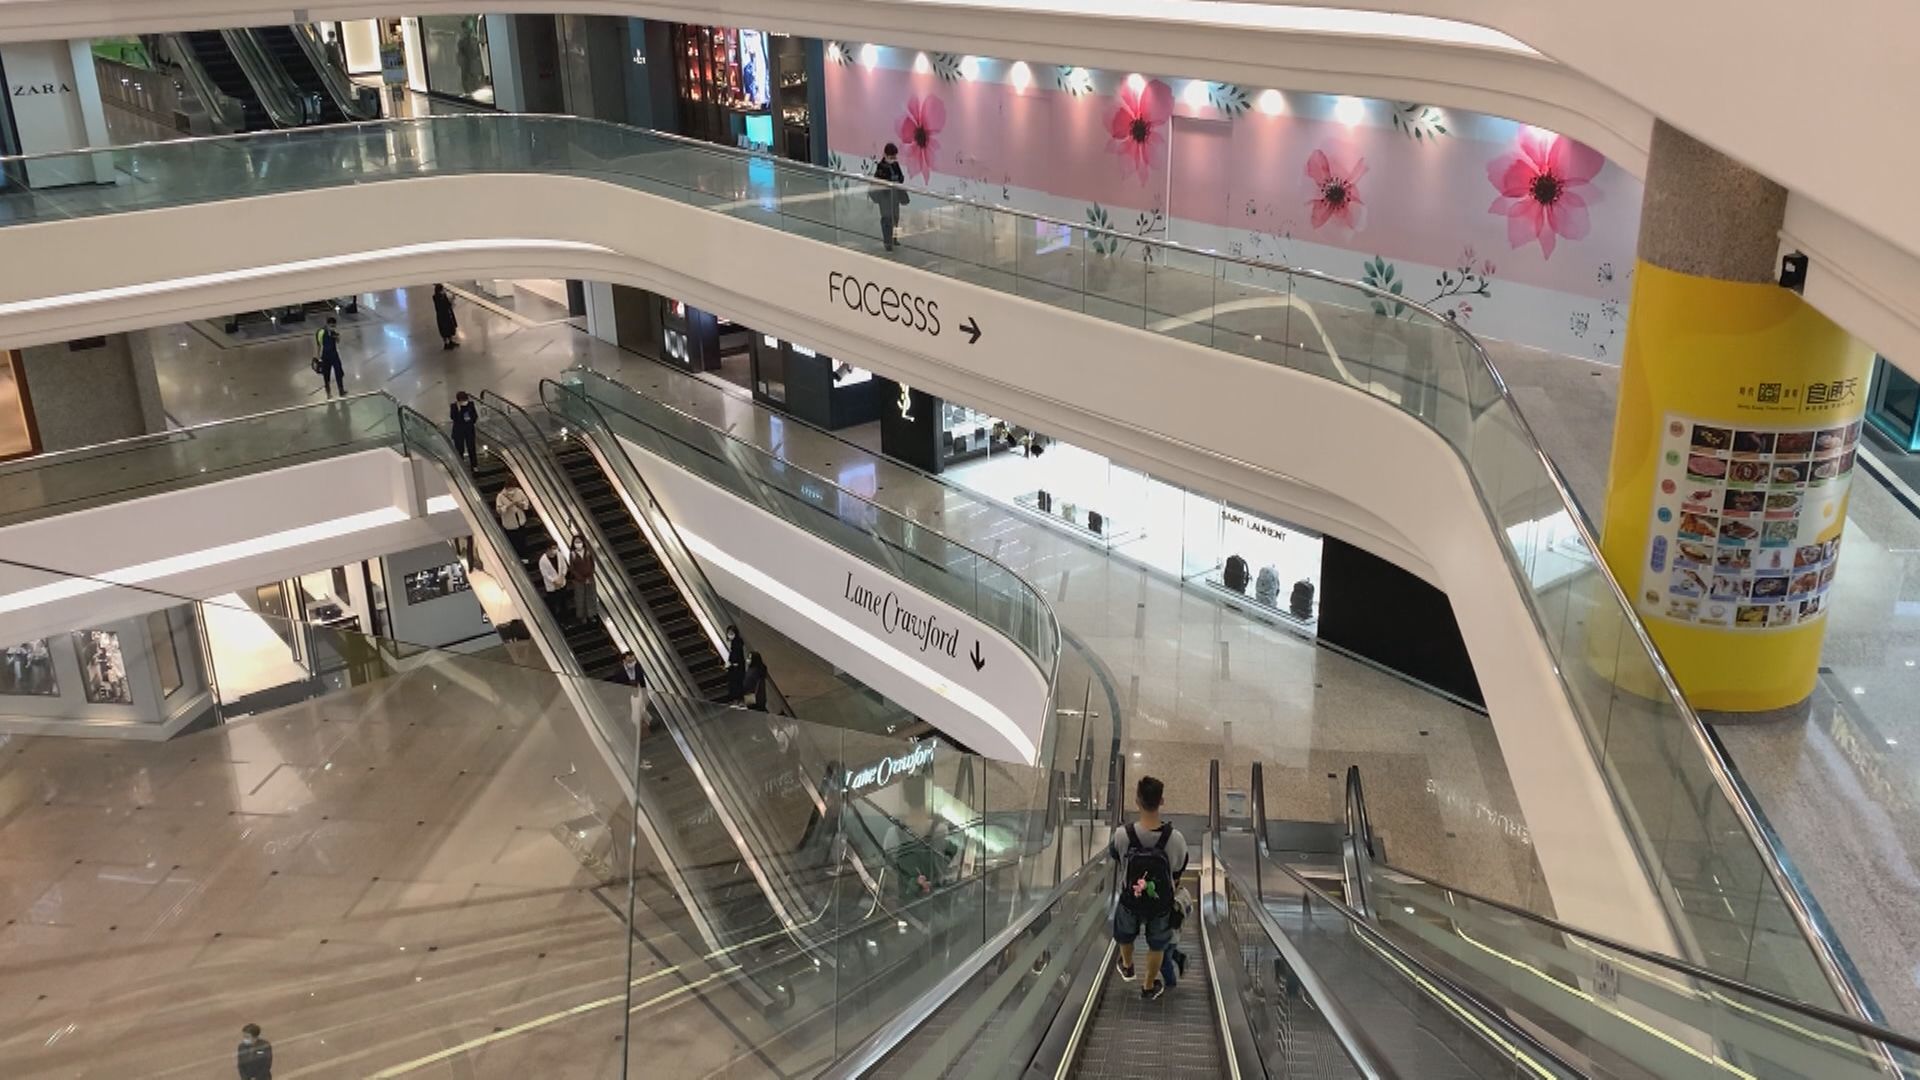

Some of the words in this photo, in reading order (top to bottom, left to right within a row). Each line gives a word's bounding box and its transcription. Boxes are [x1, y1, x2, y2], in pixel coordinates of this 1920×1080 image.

[13, 83, 71, 96] ZARA
[1221, 510, 1244, 526] SAINT
[1246, 521, 1286, 542] LAURENT
[845, 571, 881, 616] Lane
[882, 591, 959, 658] Crawford
